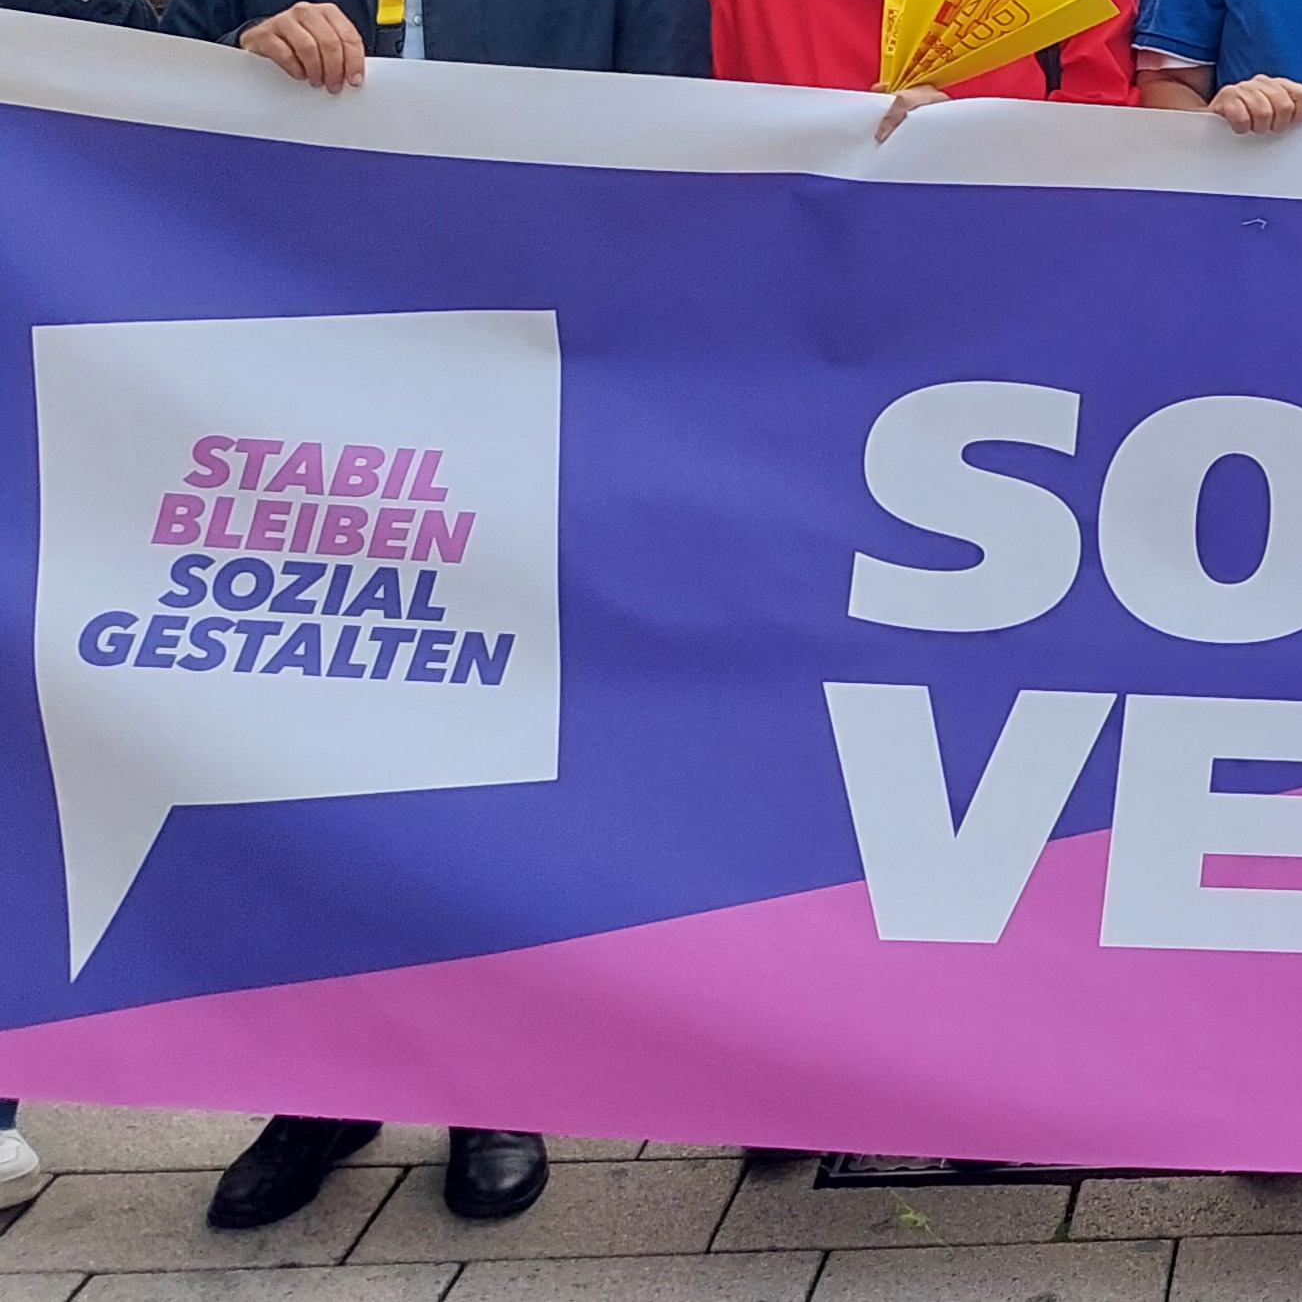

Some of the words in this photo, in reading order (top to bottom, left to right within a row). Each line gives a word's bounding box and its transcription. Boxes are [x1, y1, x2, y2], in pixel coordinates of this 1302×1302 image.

[182, 435, 450, 503] STABIL
[150, 492, 477, 564] BLEIBEN
[158, 553, 447, 622] SOZIAL
[77, 610, 516, 687] GESTALTEN
